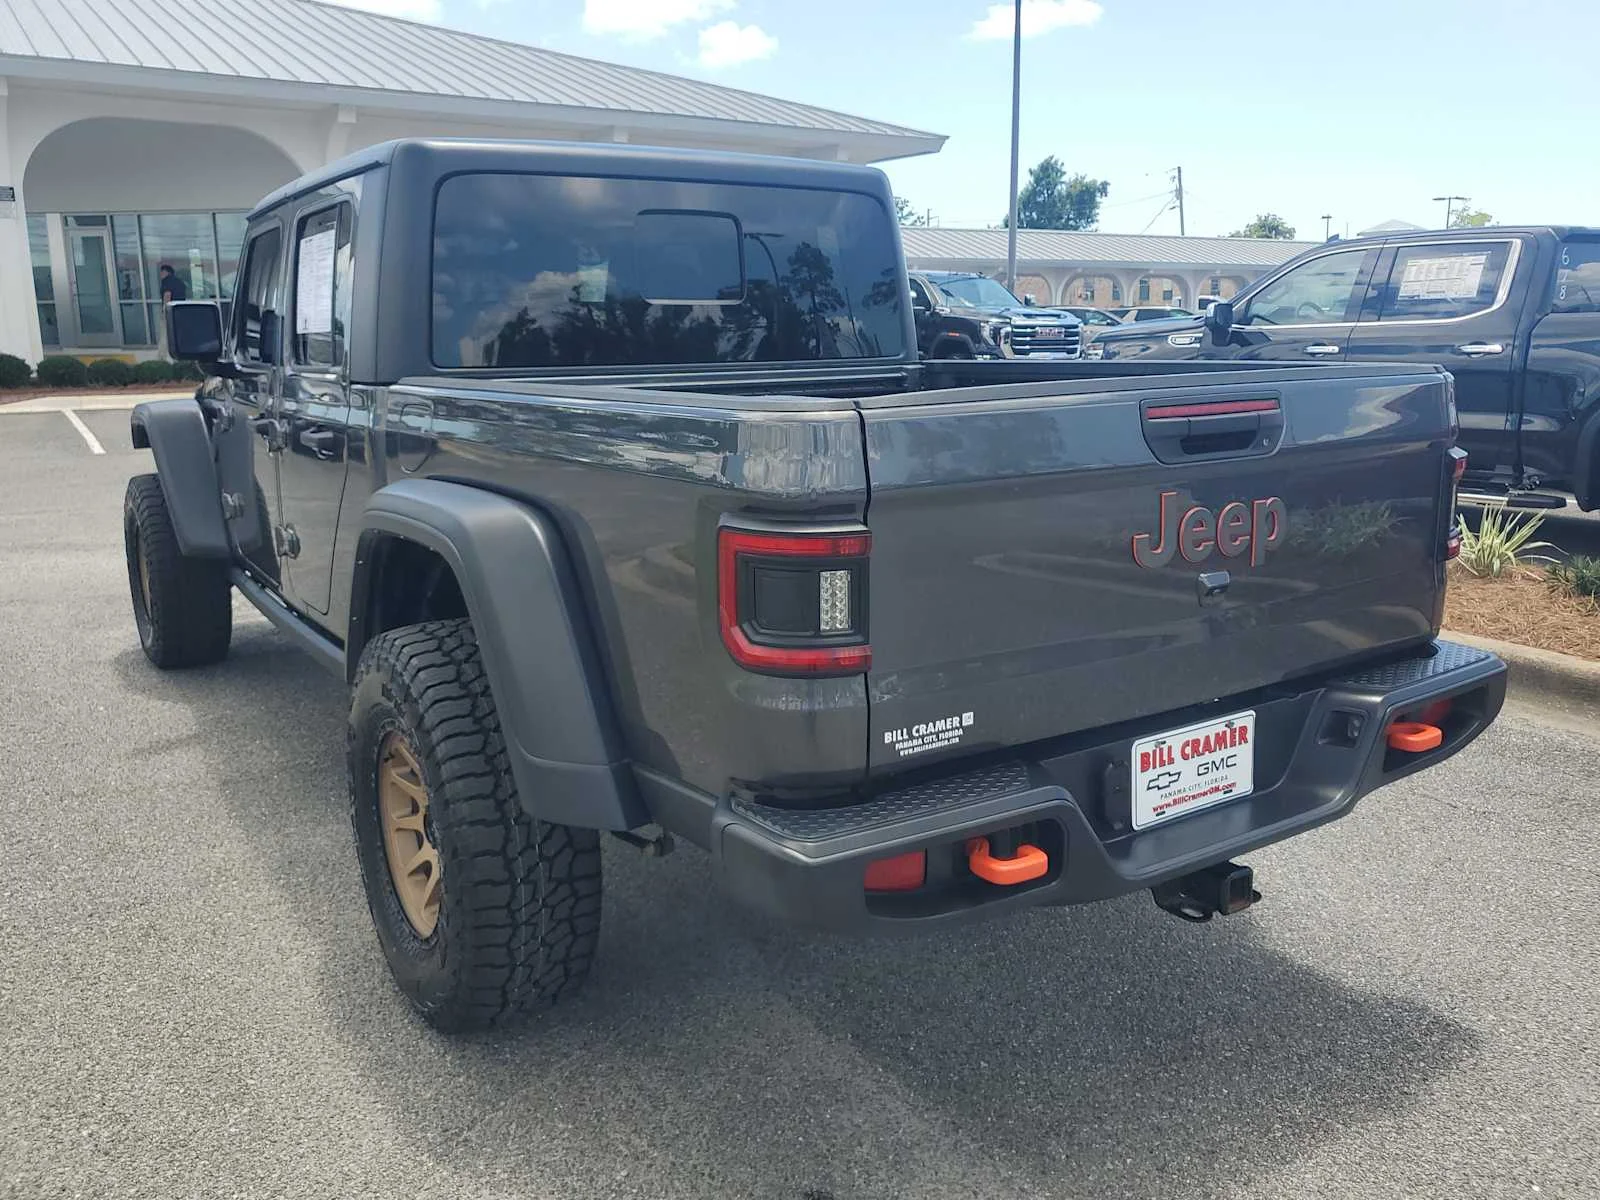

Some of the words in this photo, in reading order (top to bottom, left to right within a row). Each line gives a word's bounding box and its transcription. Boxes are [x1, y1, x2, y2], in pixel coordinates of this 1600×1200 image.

[1131, 491, 1288, 569] Jeep
[884, 728, 909, 744] BILL
[912, 716, 960, 737] CRAMER
[895, 738, 923, 751] PANAMA
[939, 728, 963, 740] FLORIDA
[1140, 744, 1175, 773] BILL
[1180, 725, 1248, 761] CRAMER
[1197, 754, 1237, 777] GMC
[1160, 786, 1187, 799] PANAMA
[1204, 774, 1228, 786] FLORIDA
